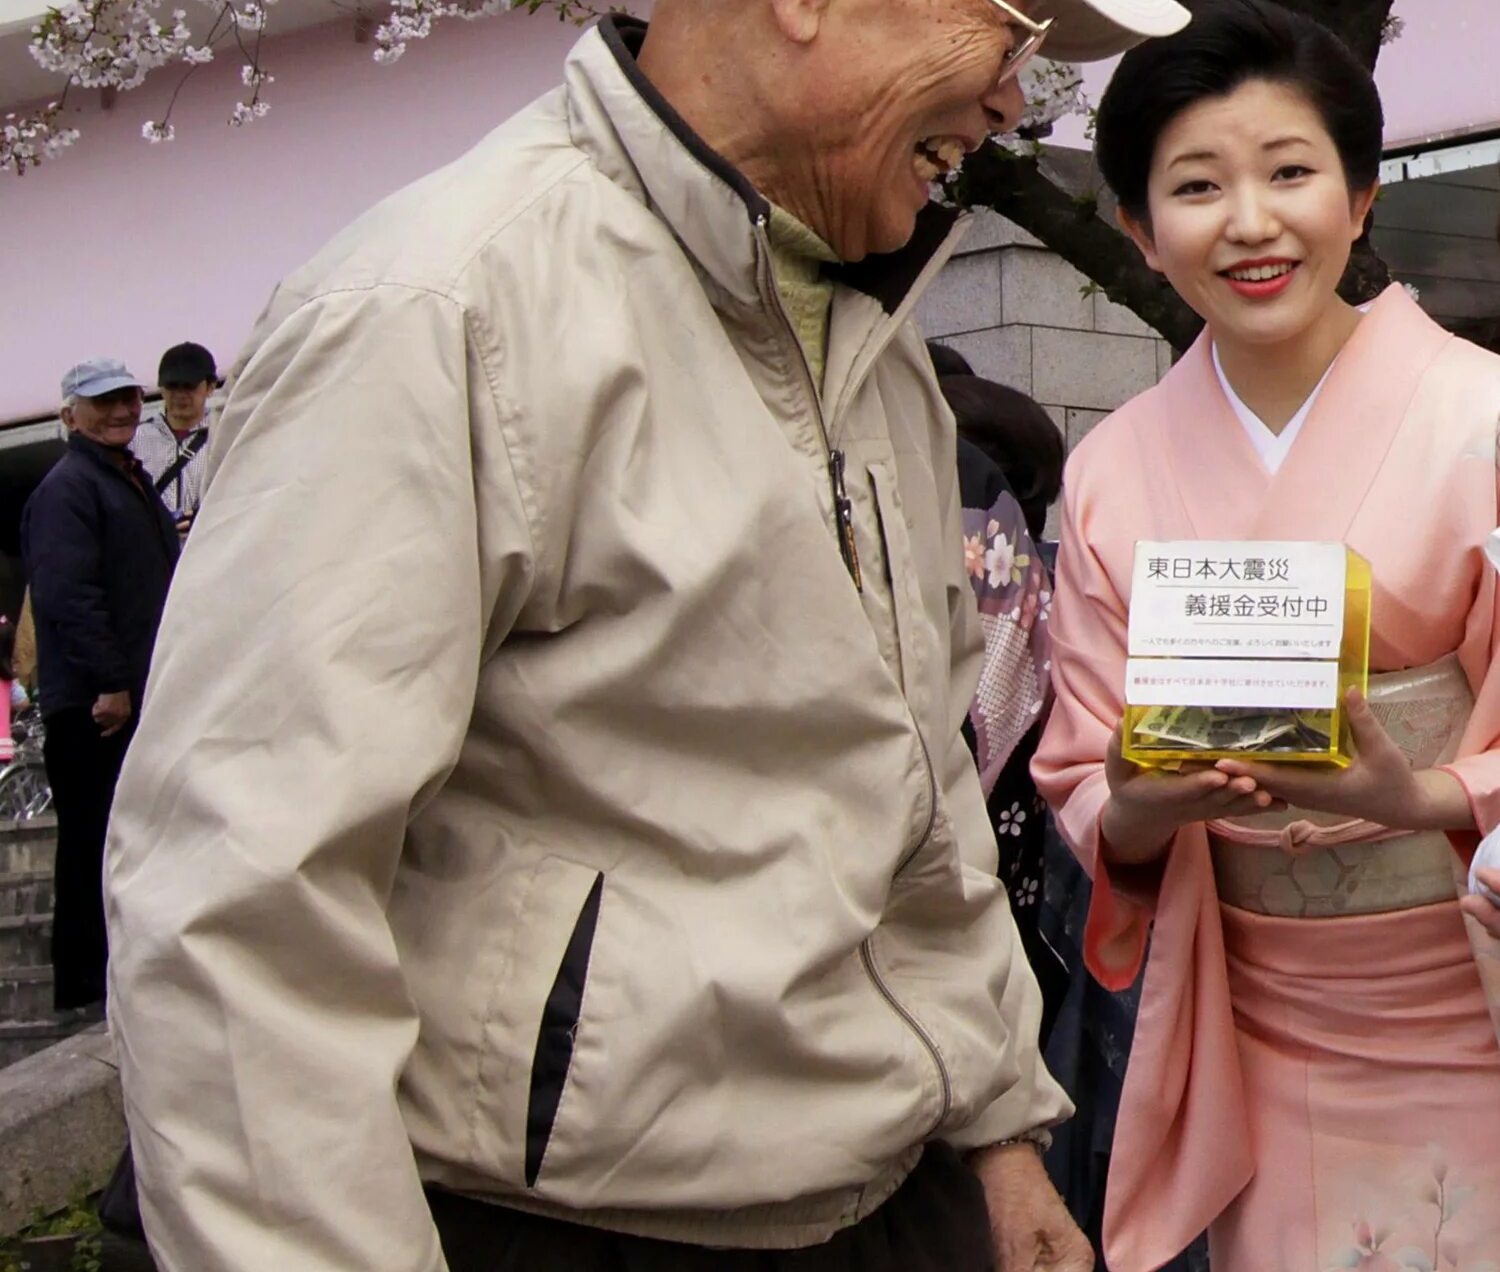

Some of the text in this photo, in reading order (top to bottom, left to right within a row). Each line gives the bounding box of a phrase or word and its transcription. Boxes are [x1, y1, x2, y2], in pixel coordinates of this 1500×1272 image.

[1147, 557, 1289, 581] 東日本大震災
[1184, 594, 1328, 618] 義援金受付中
